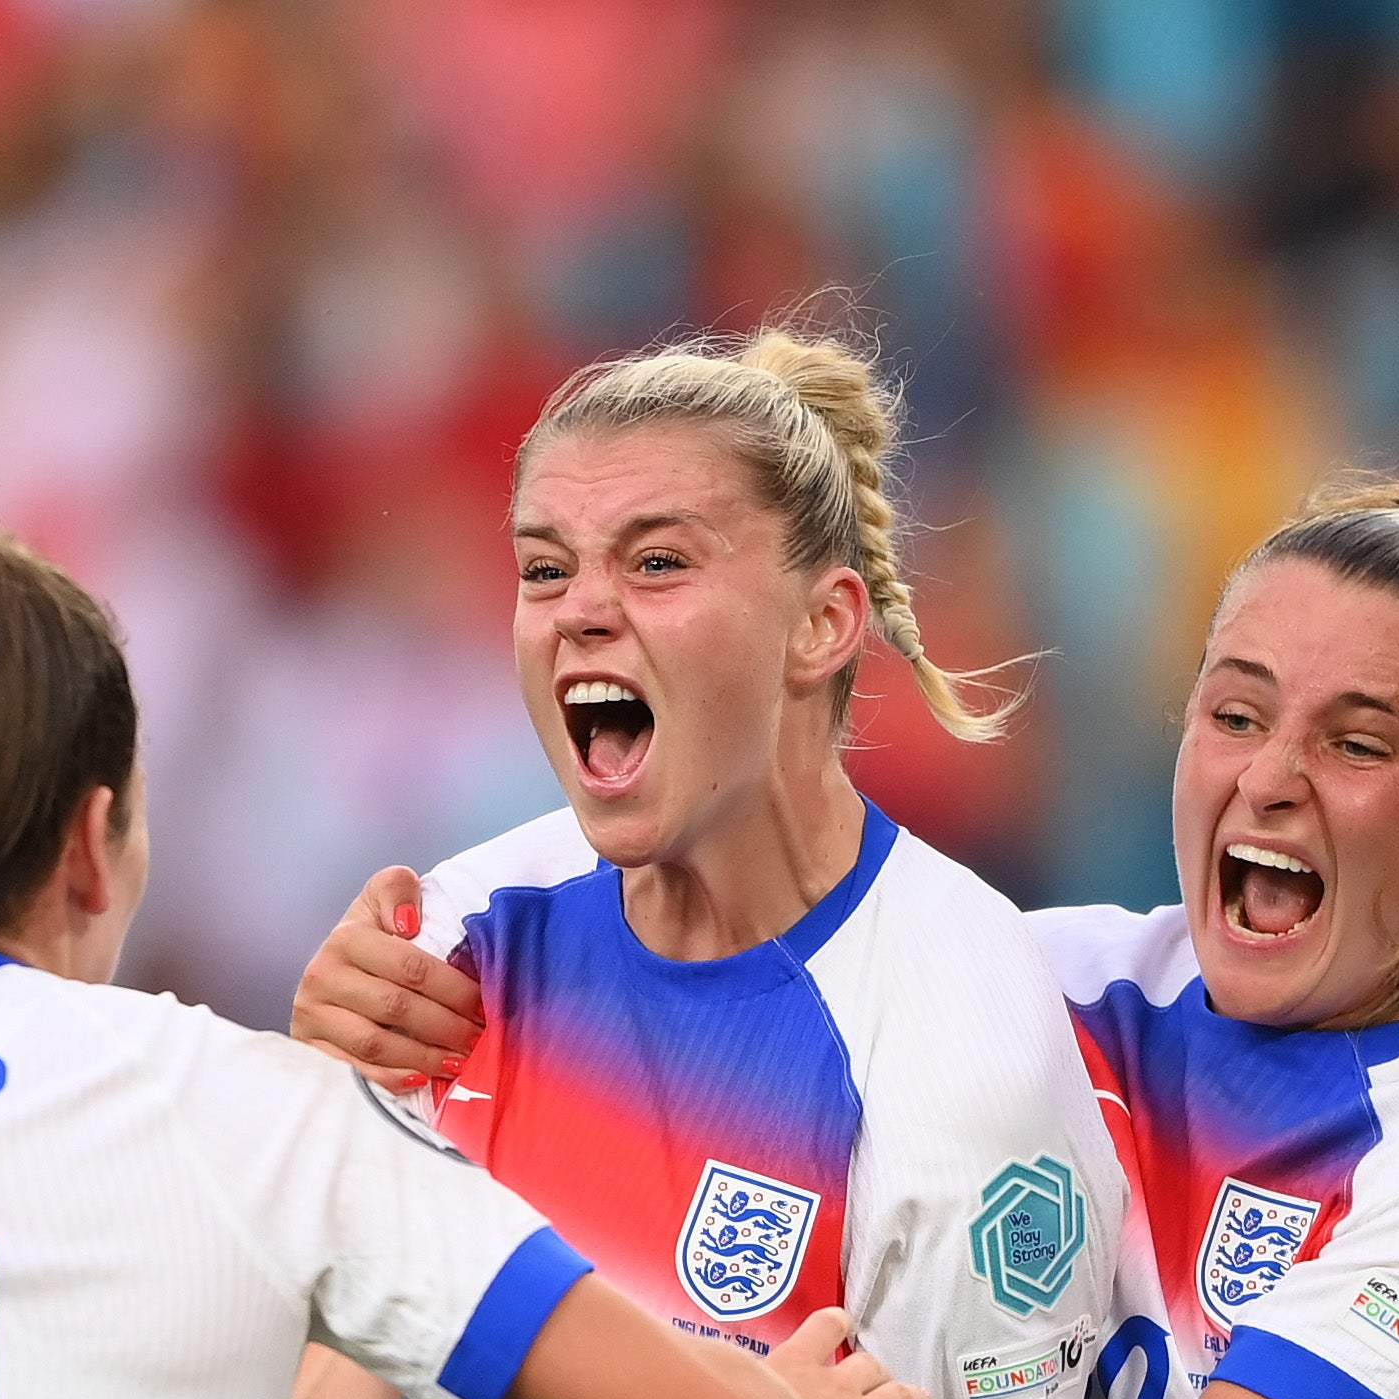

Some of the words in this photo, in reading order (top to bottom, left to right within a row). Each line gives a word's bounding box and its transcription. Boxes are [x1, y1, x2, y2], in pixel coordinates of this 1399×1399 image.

[1008, 1210, 1031, 1227] We
[1010, 1229, 1041, 1248] Play
[1012, 1242, 1056, 1265] Strong
[1367, 1277, 1398, 1302] UEFA
[735, 1334, 770, 1356] SPAIN
[1058, 1334, 1083, 1372] 10
[963, 1356, 998, 1371] UEFA
